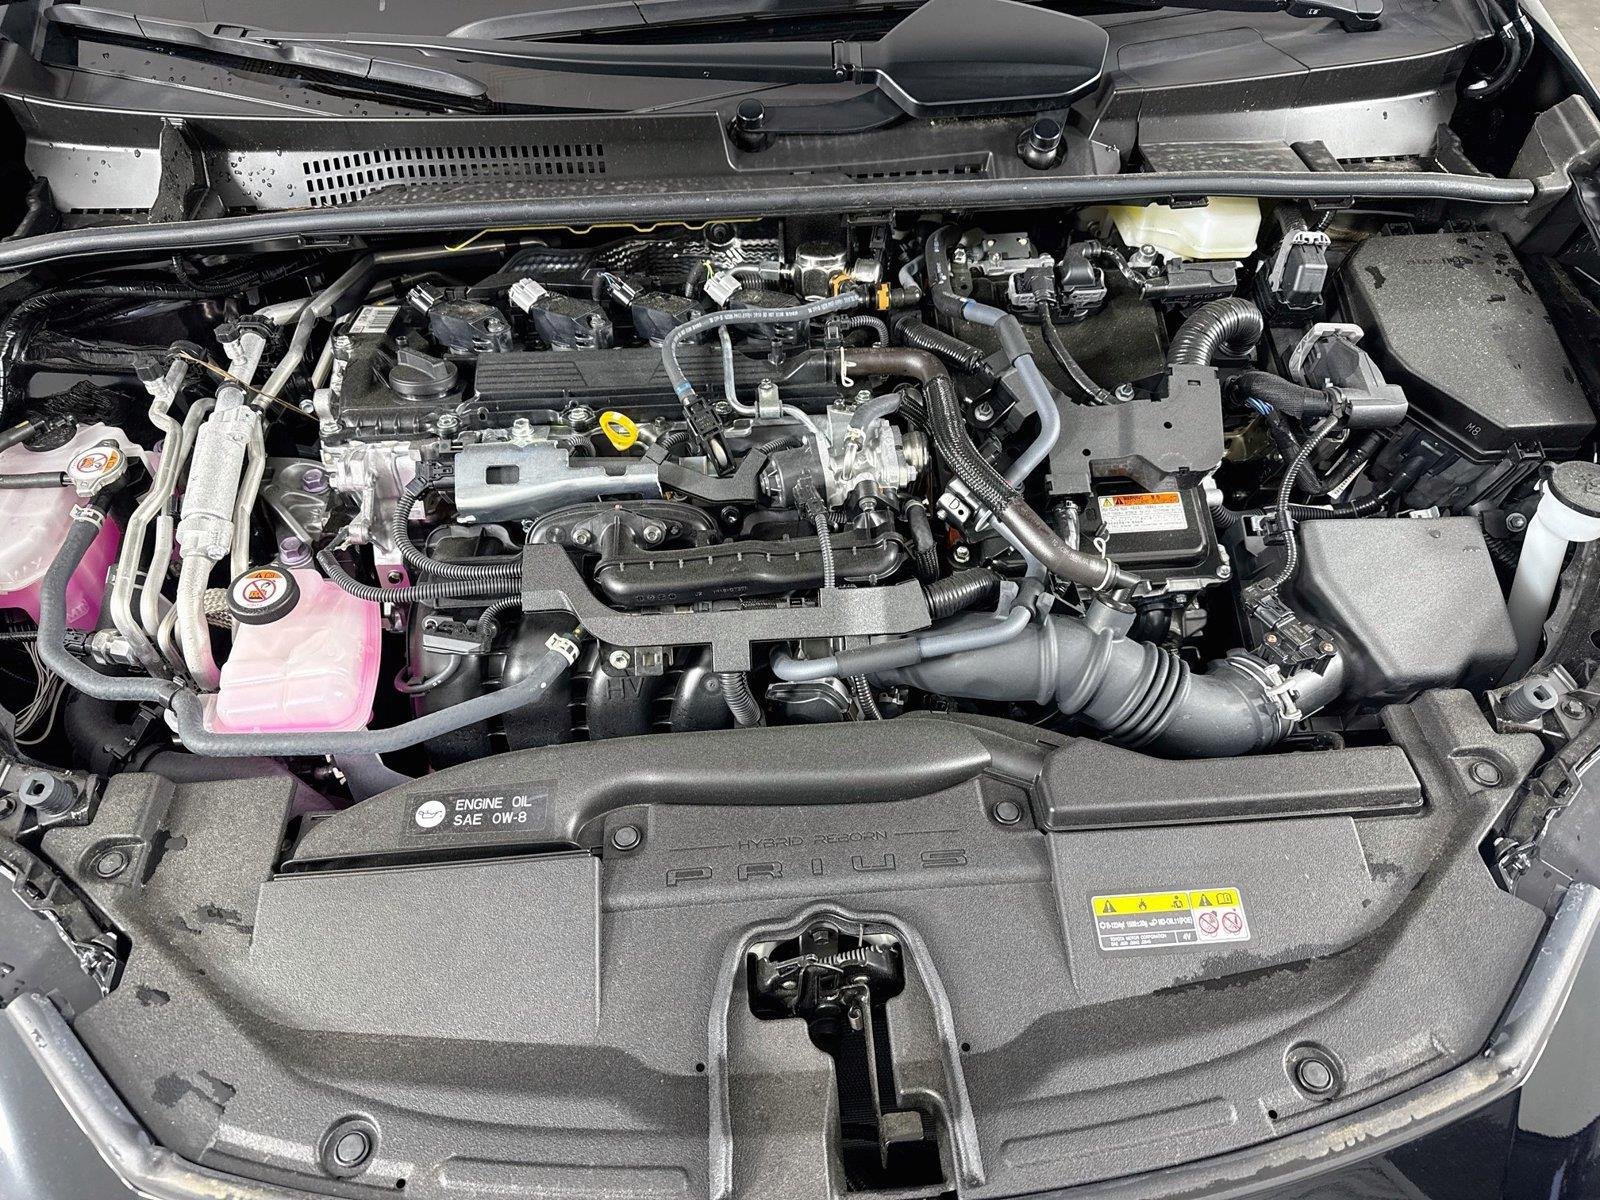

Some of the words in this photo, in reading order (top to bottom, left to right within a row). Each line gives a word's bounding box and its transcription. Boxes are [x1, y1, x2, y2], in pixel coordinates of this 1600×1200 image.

[455, 797, 504, 811] ENGINE
[511, 795, 532, 808] OIL
[453, 813, 483, 826] SAE
[738, 836, 804, 850] HYBRID
[813, 830, 888, 845] REBORN
[666, 848, 968, 887] PRIUS
